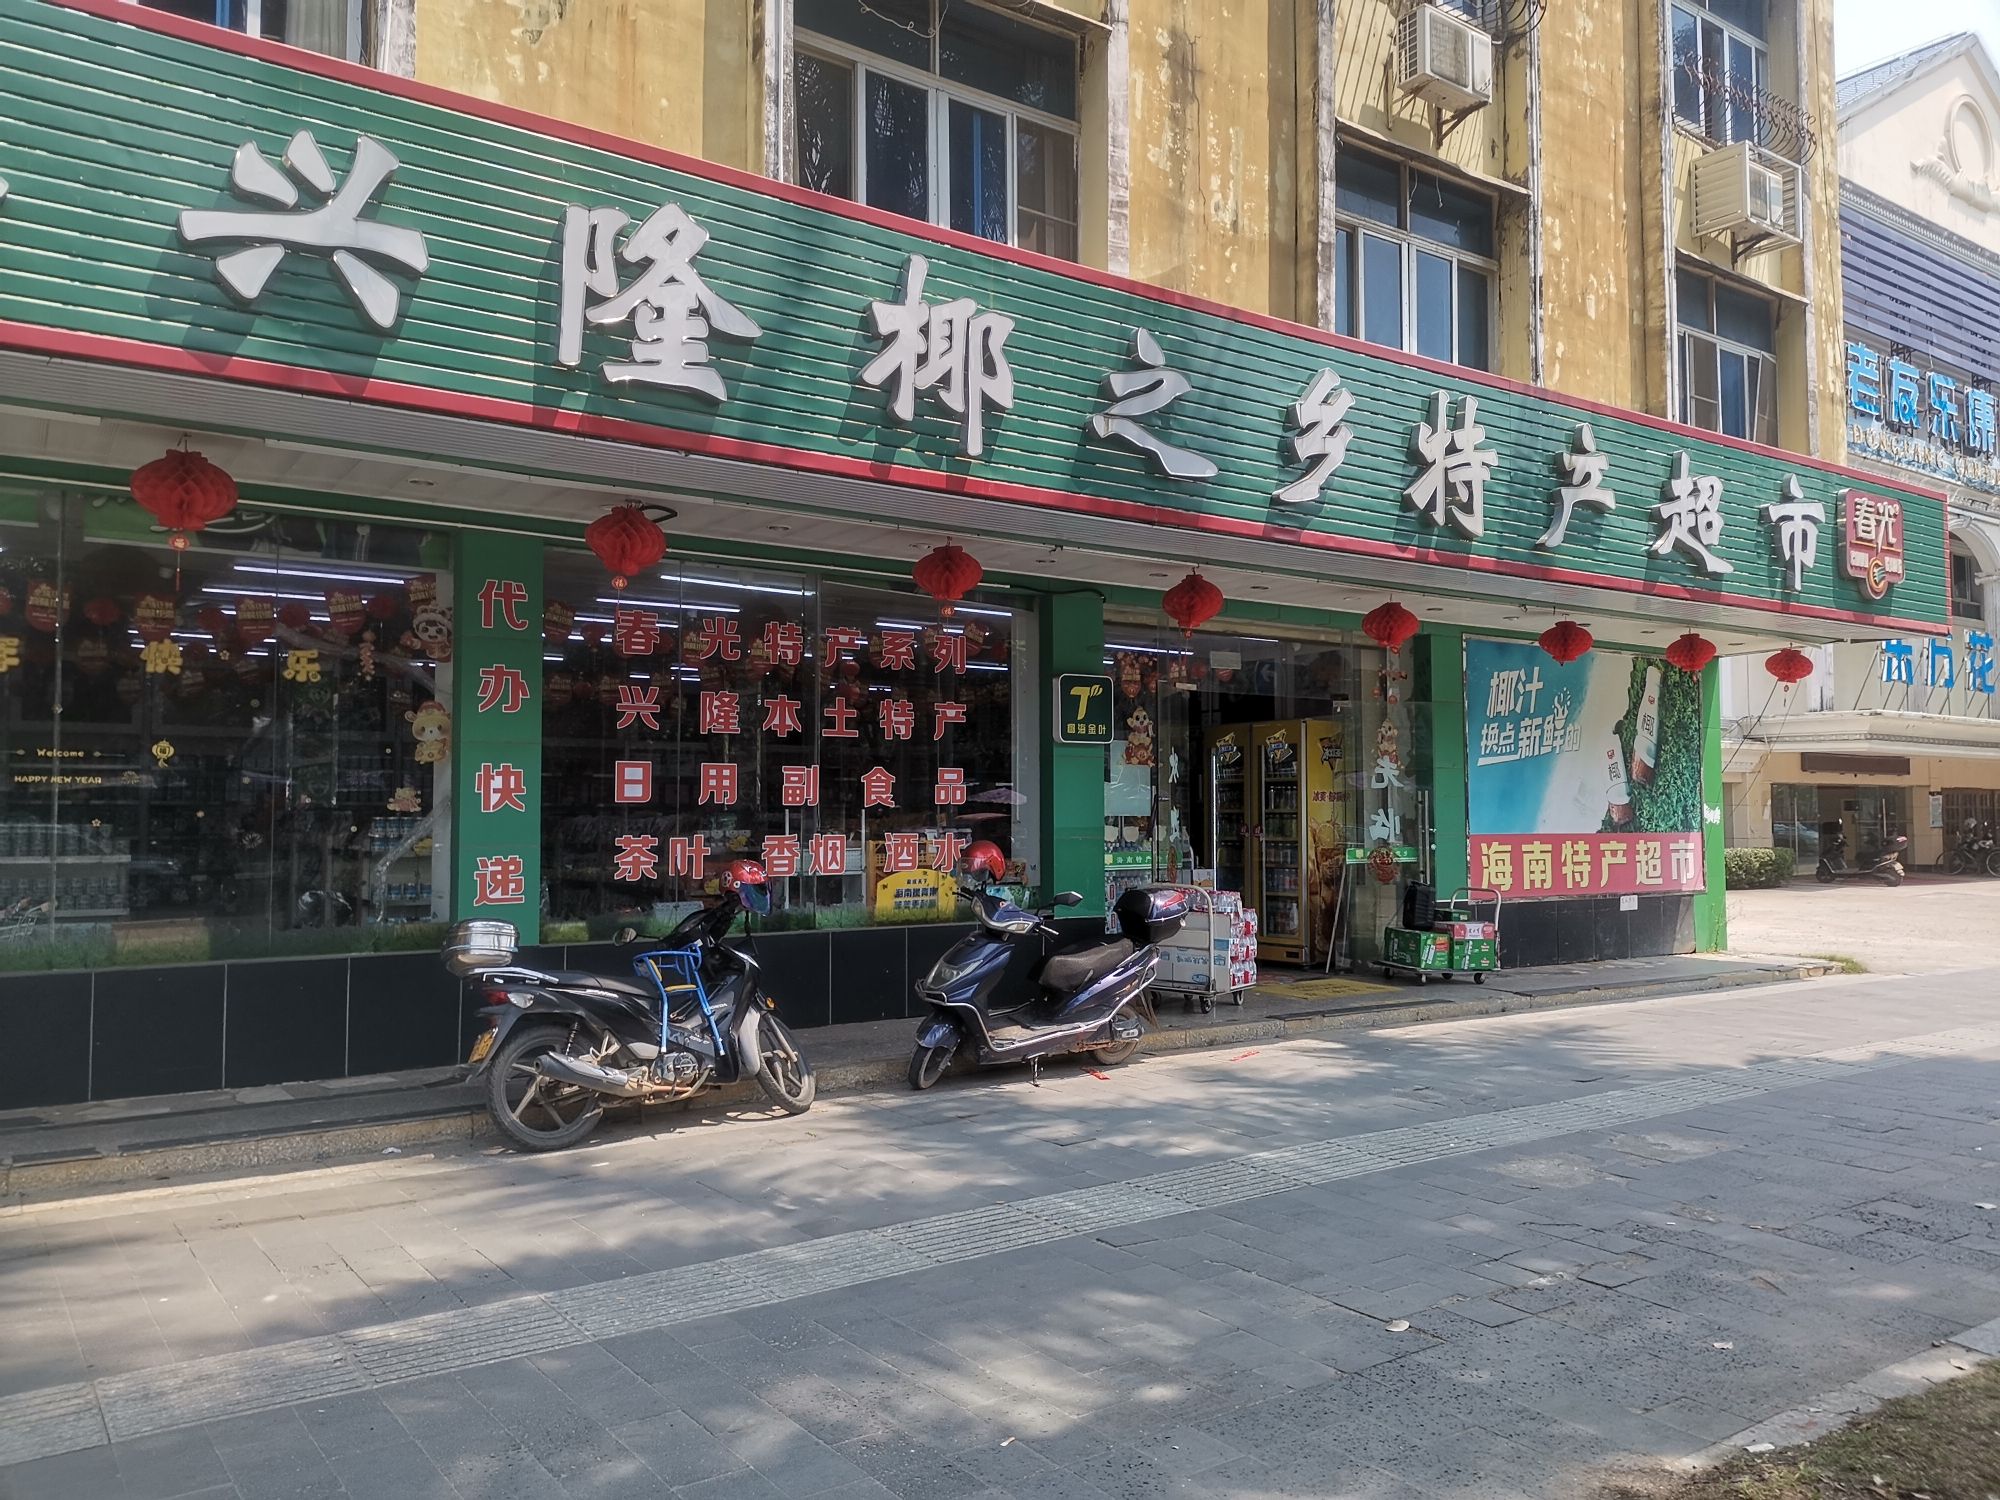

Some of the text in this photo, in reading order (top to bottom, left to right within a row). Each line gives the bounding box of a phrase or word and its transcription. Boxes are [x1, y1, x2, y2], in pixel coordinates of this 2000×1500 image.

[178, 128, 1826, 592] 兴隆椰之乡特产超市
[1853, 497, 1900, 553] 春光
[616, 610, 967, 675] 春光特产系列
[616, 685, 967, 740] 兴隆本土特产
[1486, 666, 1544, 718] 椰汁
[36, 748, 84, 758] Welcome
[474, 579, 530, 906] 代办快递
[14, 775, 102, 784] HAPPY NEW YEAR
[614, 760, 967, 808] 日用副食品
[614, 832, 966, 881] 茶叶 香烟 酒水
[1480, 839, 1695, 892] 海南特产超市
